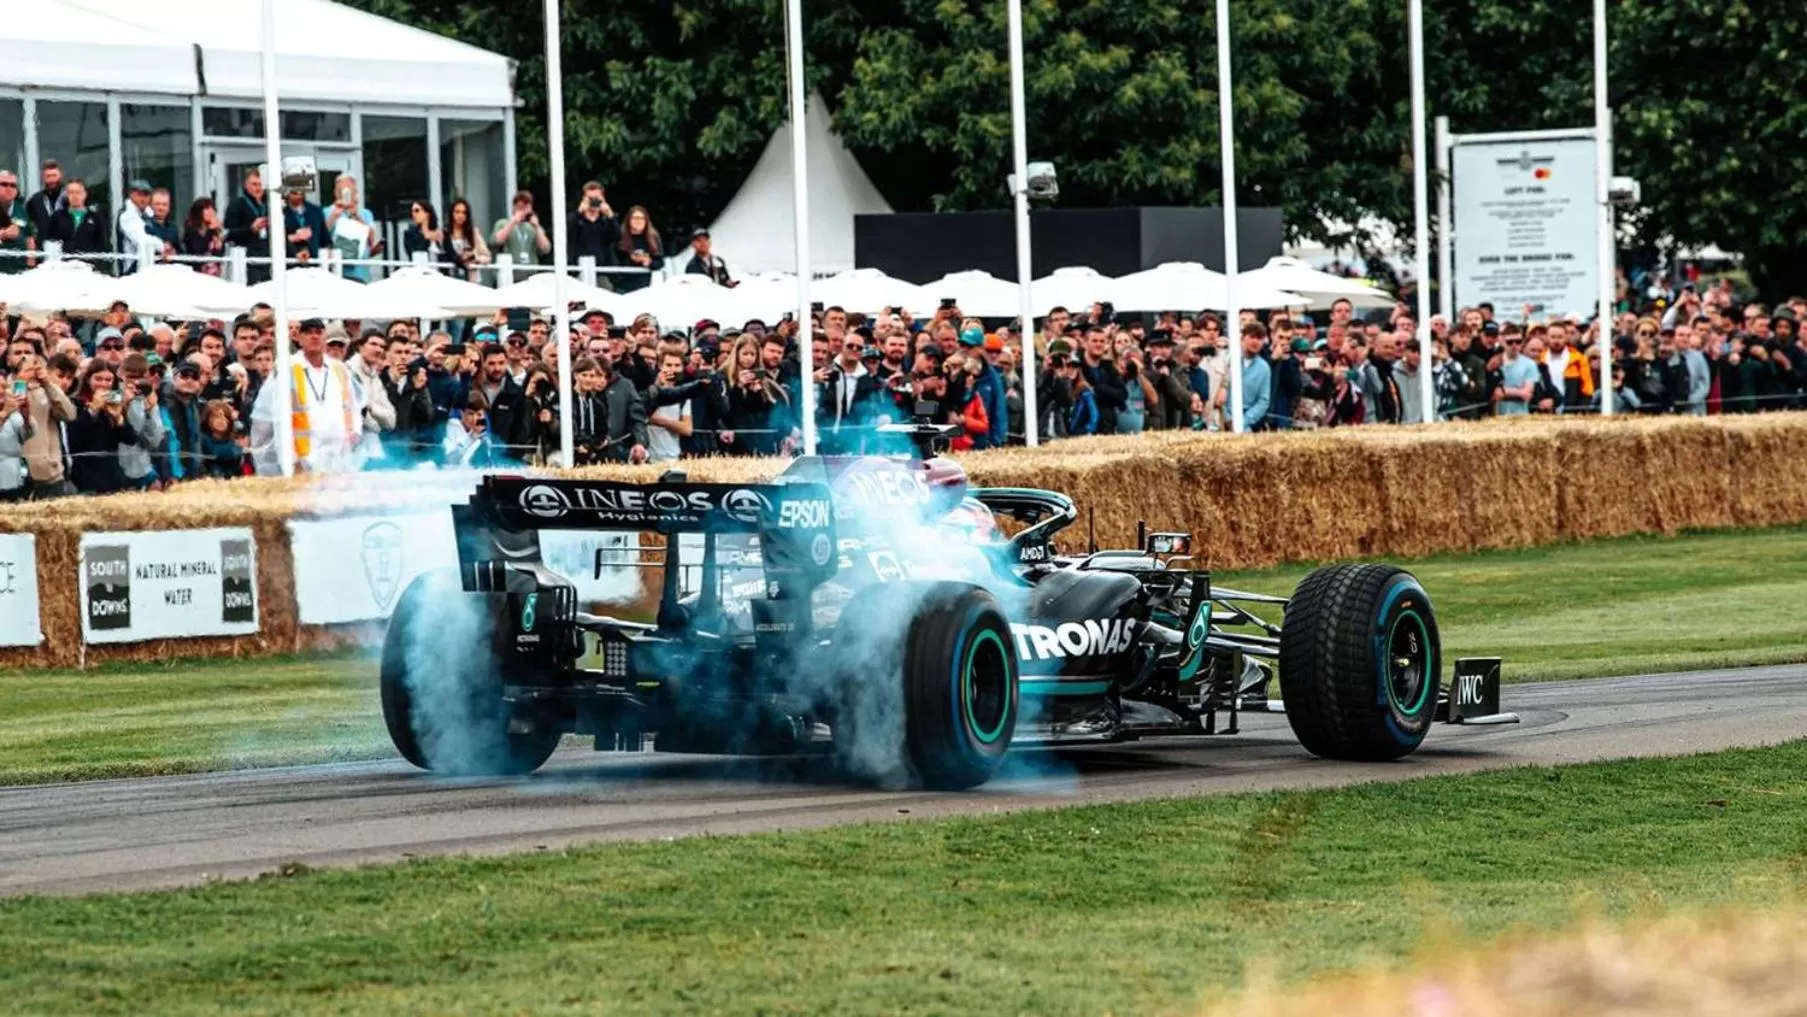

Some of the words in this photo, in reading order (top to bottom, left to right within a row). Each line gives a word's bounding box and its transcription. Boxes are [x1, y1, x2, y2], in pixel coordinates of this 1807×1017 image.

[573, 487, 713, 511] INEOS
[598, 511, 699, 522] Hygienics
[778, 499, 830, 529] EPSON
[90, 559, 127, 577] SOUTH
[136, 563, 178, 580] NATURAL
[180, 560, 217, 578] MINERAL
[164, 588, 192, 606] WATER
[92, 599, 128, 617] DOWNS
[1456, 674, 1484, 706] IWC
